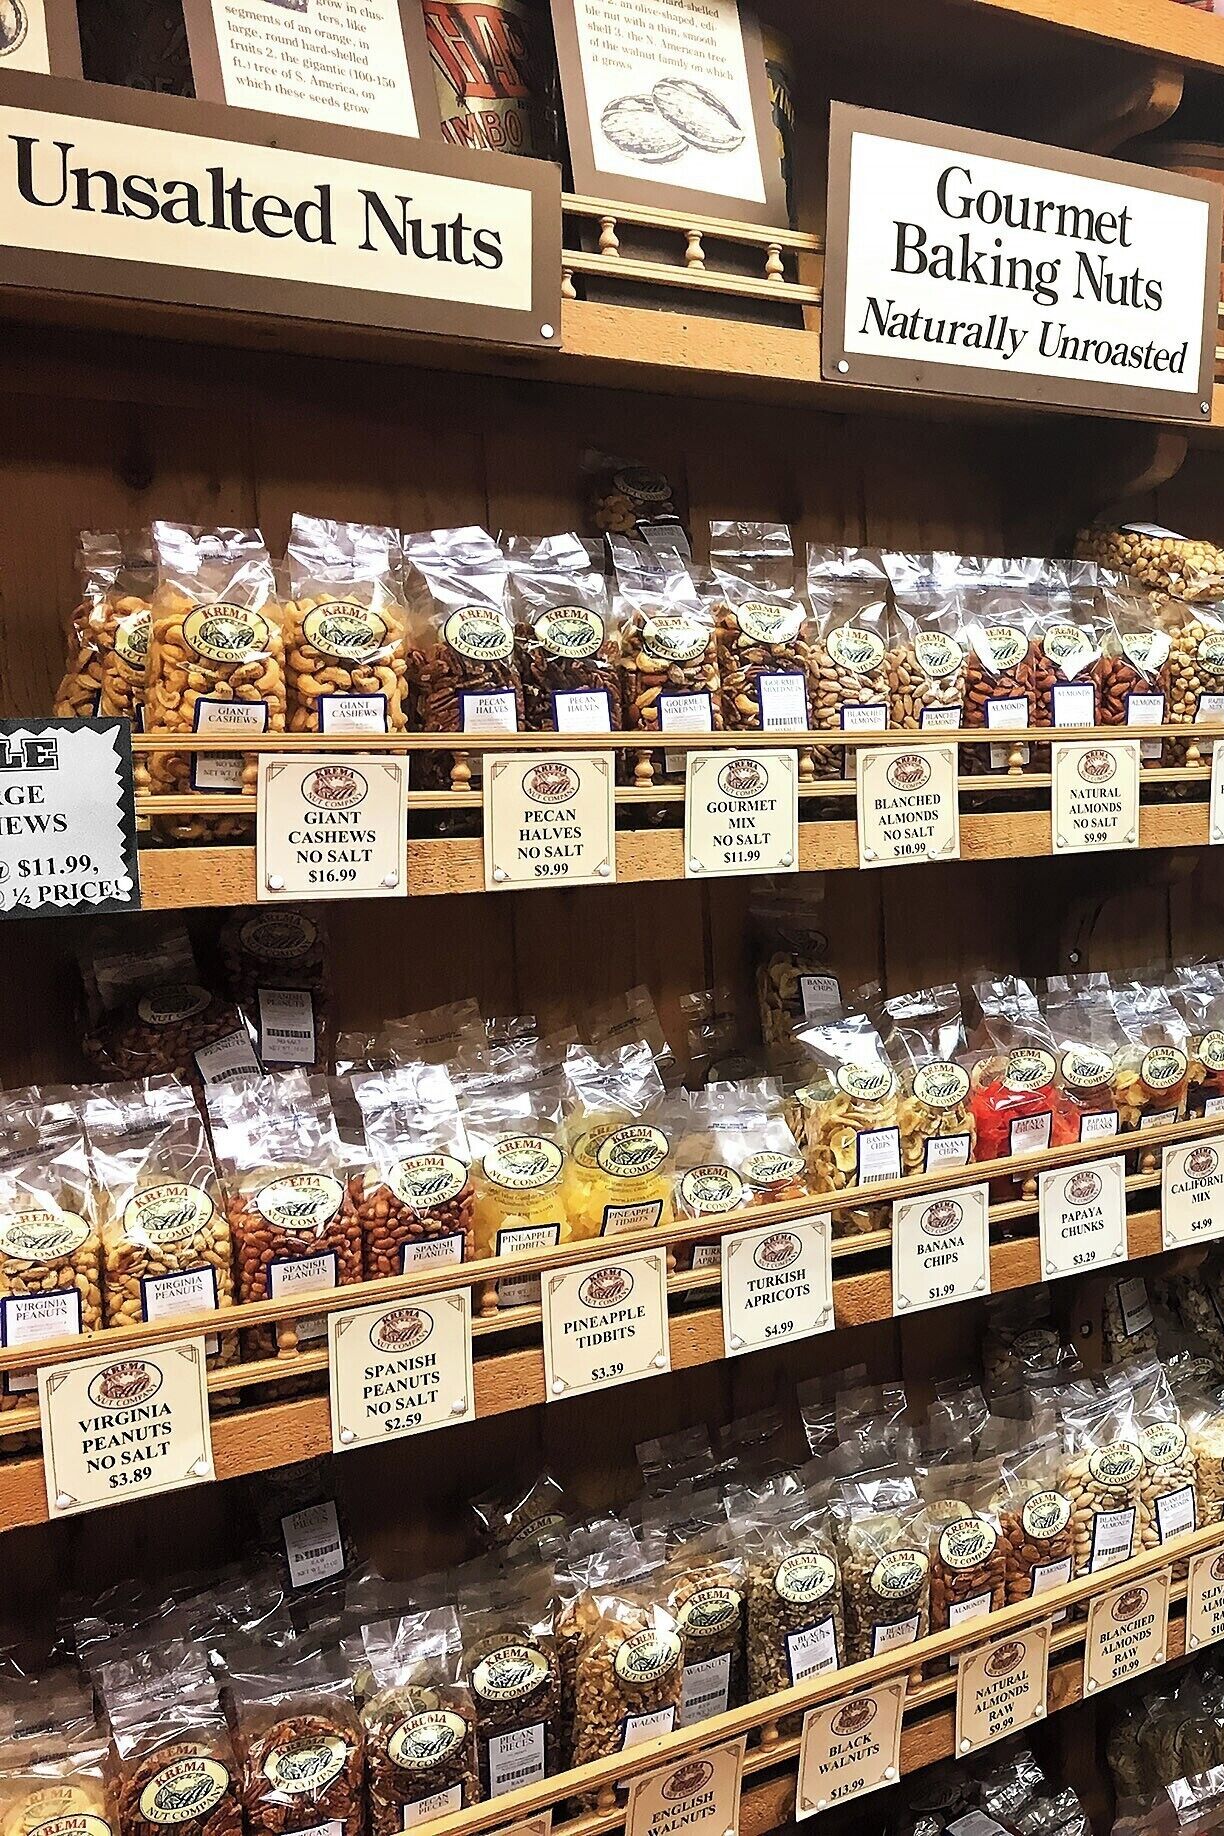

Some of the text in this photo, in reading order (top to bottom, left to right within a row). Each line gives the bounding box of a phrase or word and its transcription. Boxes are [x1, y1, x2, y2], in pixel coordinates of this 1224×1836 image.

[224, 4, 370, 50] segments of an orange, in
[227, 20, 369, 66] large, round hard-shelled
[235, 75, 371, 115] which these seeds grow
[8, 135, 503, 270] Unsalted Nuts
[936, 165, 1133, 248] Gourmet
[890, 220, 1165, 313] Baking Nuts
[858, 297, 1189, 375] Naturally Unroasted
[202, 607, 249, 623] KREMA
[459, 608, 501, 623] KREMA
[545, 608, 590, 624] KREMA
[208, 714, 258, 724] CASHEWS
[217, 707, 252, 716] GIANT
[314, 767, 355, 780] KREMA
[4, 785, 45, 805] GE
[306, 790, 365, 809] NUT COMPANY
[874, 793, 941, 810] BLANCHED
[1069, 787, 1121, 800] NATURAL
[524, 809, 577, 823] PECAN
[706, 799, 777, 814] GOURMET
[1068, 802, 1122, 815] ALMONDS
[0, 814, 68, 836] EWS
[303, 811, 362, 825] GIANT
[728, 817, 756, 829] MIX
[877, 810, 939, 826] ALMONDS
[1072, 816, 1119, 829] NO SALT
[288, 829, 376, 845] CASHEWS
[519, 827, 582, 842] HALVES
[713, 832, 771, 847] NO SALT
[883, 825, 935, 841] NO SALT
[1084, 832, 1107, 843] $9.99
[296, 848, 373, 864] NO SALT
[517, 843, 584, 860] NO SALT
[723, 850, 761, 864] $11.99
[893, 842, 926, 856] $10.99
[17, 855, 100, 879] $11.99,
[308, 868, 357, 884] $16.99
[533, 863, 569, 877] $9.99
[1191, 1189, 1211, 1204] MIX
[1060, 1206, 1103, 1224] PAPAYA
[1060, 1220, 1105, 1239] CHUNKS
[1191, 1218, 1213, 1232] $4.99
[916, 1236, 965, 1256] BANANA
[923, 1252, 959, 1270] CHIPS
[1072, 1250, 1096, 1265] $3.29
[746, 1267, 807, 1292] TURKISH
[743, 1282, 811, 1310] APRICOTS
[928, 1283, 955, 1300] $1.99
[14, 1299, 67, 1313] VIRGINIA
[16, 1308, 68, 1321] PEANUTS
[563, 1305, 646, 1335] PINEAPPLE
[764, 1320, 794, 1338] $4.99
[575, 1324, 636, 1351] TIDBITS
[364, 1352, 437, 1380] SPANISH
[591, 1362, 624, 1382] $3.39
[362, 1371, 441, 1400] PEANUTS
[365, 1389, 439, 1418] NO SALT
[78, 1401, 172, 1434] VIRGINIA
[384, 1412, 422, 1433] $2.59
[81, 1421, 172, 1455] PEANUTS
[86, 1441, 171, 1474] NO SALT
[108, 1466, 152, 1489] $3.89
[1099, 1613, 1155, 1644] BLANCHED
[1101, 1628, 1152, 1656] ALMONDS
[1113, 1647, 1139, 1664] RAW
[1111, 1659, 1140, 1679] $10.99
[975, 1670, 1029, 1700] NATURAL
[973, 1682, 1030, 1715] ALMONDS
[988, 1702, 1015, 1723] RAW
[989, 1717, 1014, 1737] $9.99
[828, 1732, 872, 1759] BLACK
[818, 1744, 880, 1775] WALNUTS
[830, 1778, 865, 1801] $13.99
[651, 1791, 715, 1824] ENGLISH
[646, 1805, 716, 1836] WALNUTS
